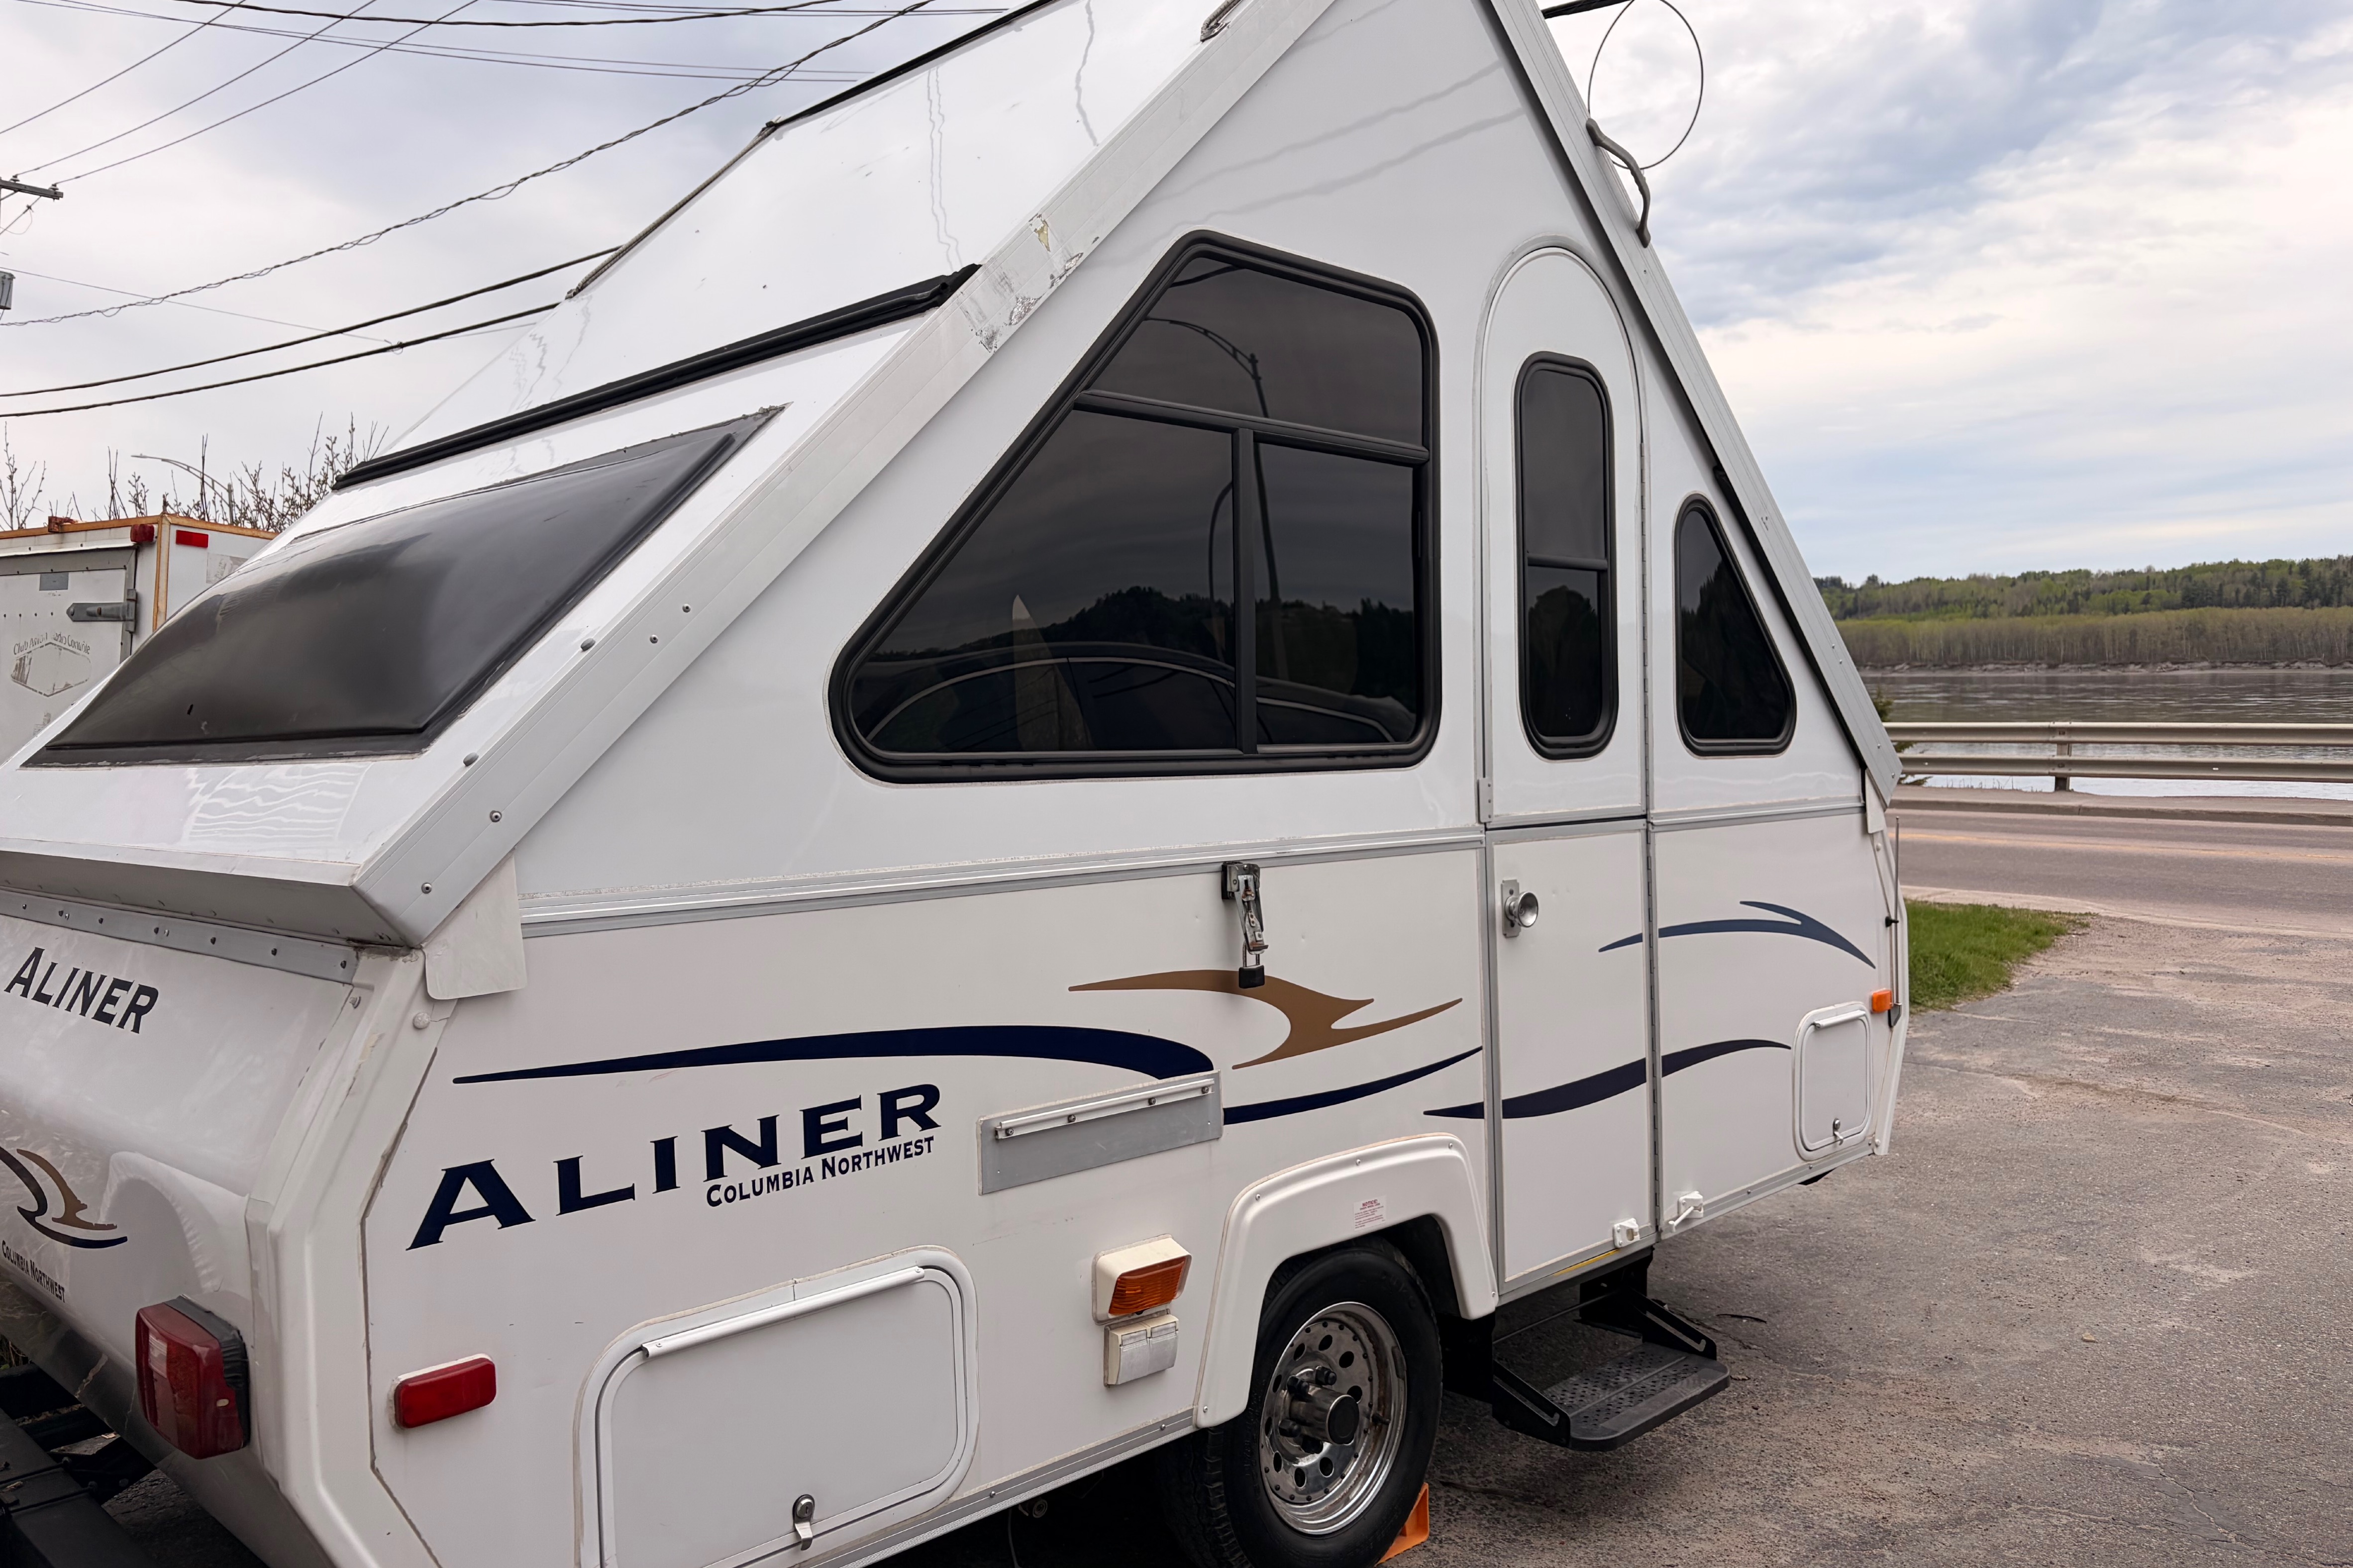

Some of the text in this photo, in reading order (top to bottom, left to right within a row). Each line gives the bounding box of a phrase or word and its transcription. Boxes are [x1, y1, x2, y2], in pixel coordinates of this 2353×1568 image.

[13, 641, 28, 655] Club
[4, 947, 159, 1034] ALINER
[406, 1083, 942, 1251] ALINER
[706, 1136, 934, 1207] COLUMBIA NORTHWEST
[2, 1240, 65, 1303] COLUMBIA NORTHWEST
